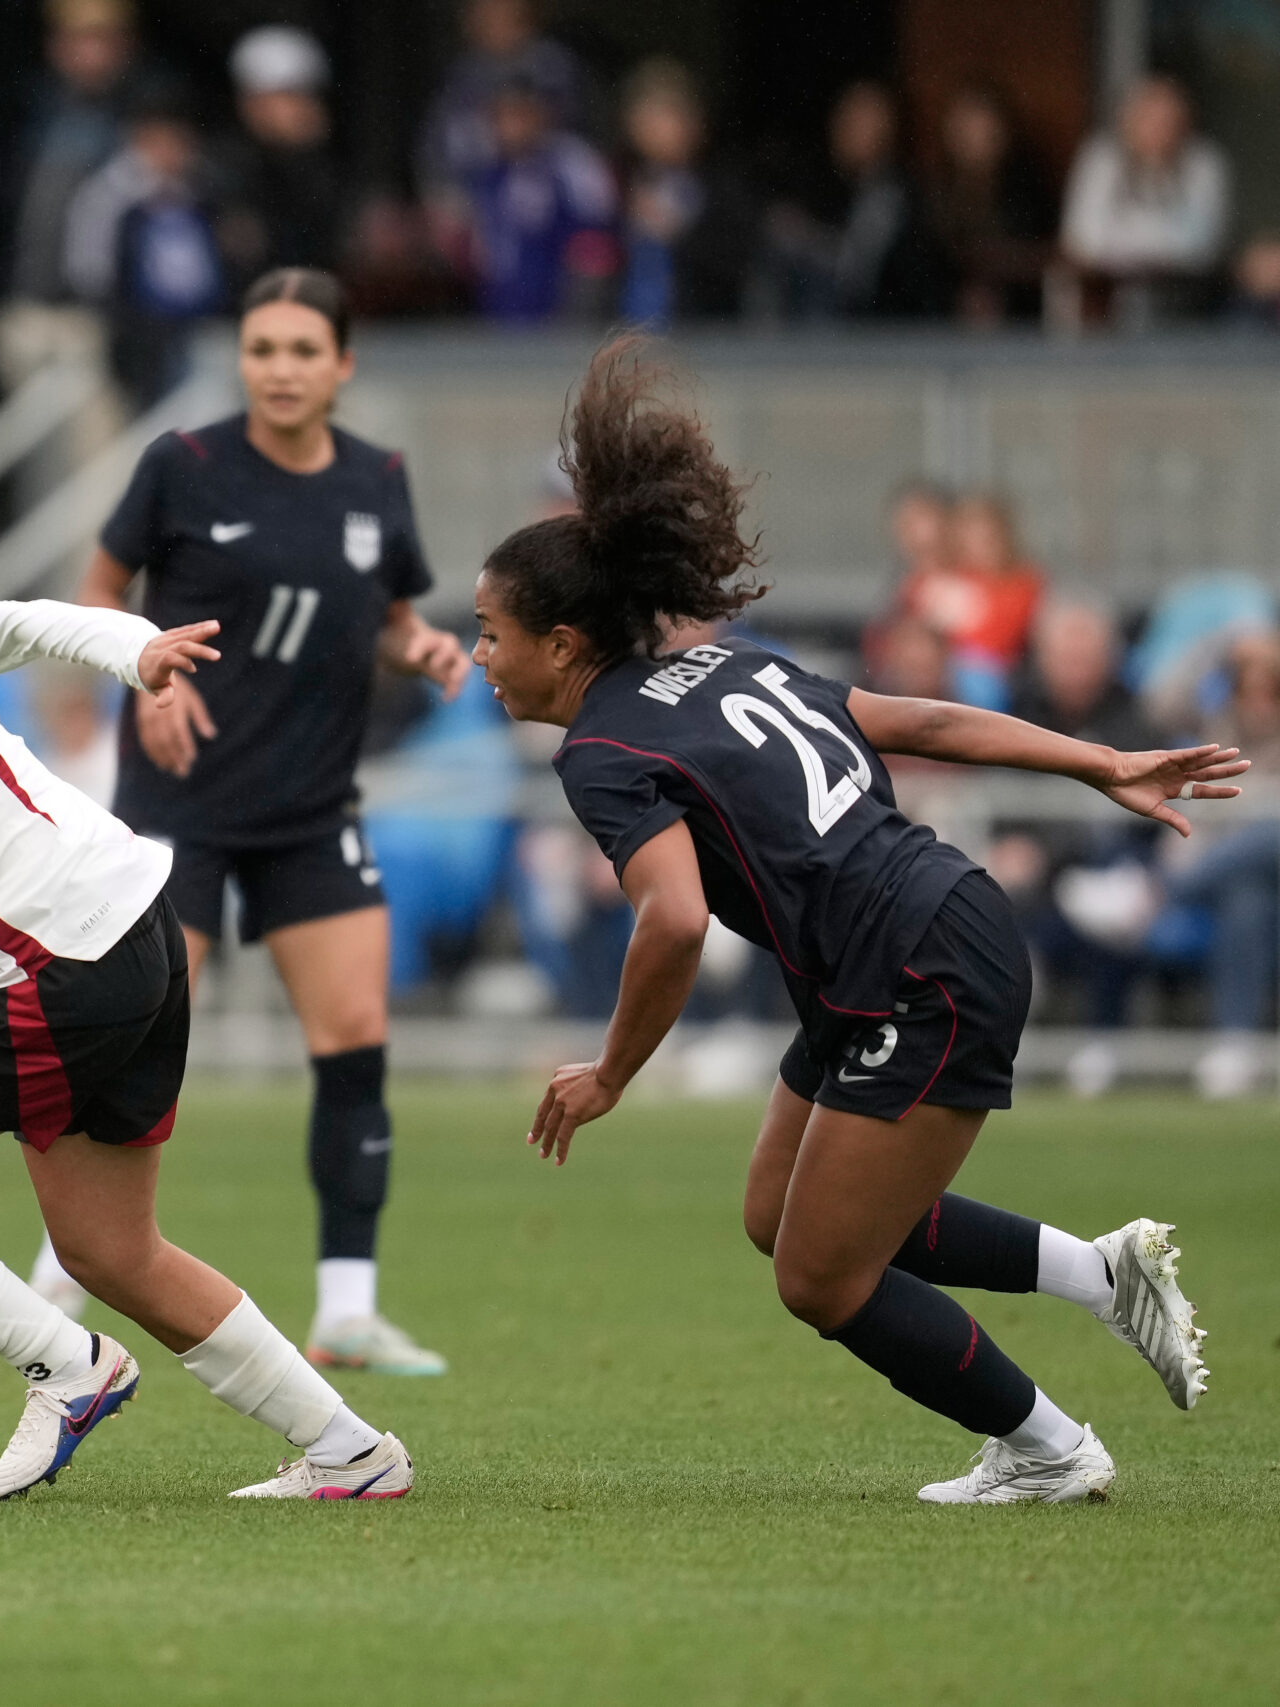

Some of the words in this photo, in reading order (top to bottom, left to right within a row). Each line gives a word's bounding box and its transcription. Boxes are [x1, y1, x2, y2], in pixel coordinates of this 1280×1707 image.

[253, 583, 321, 663] 11
[638, 644, 734, 706] WESLEY
[720, 662, 872, 837] 25
